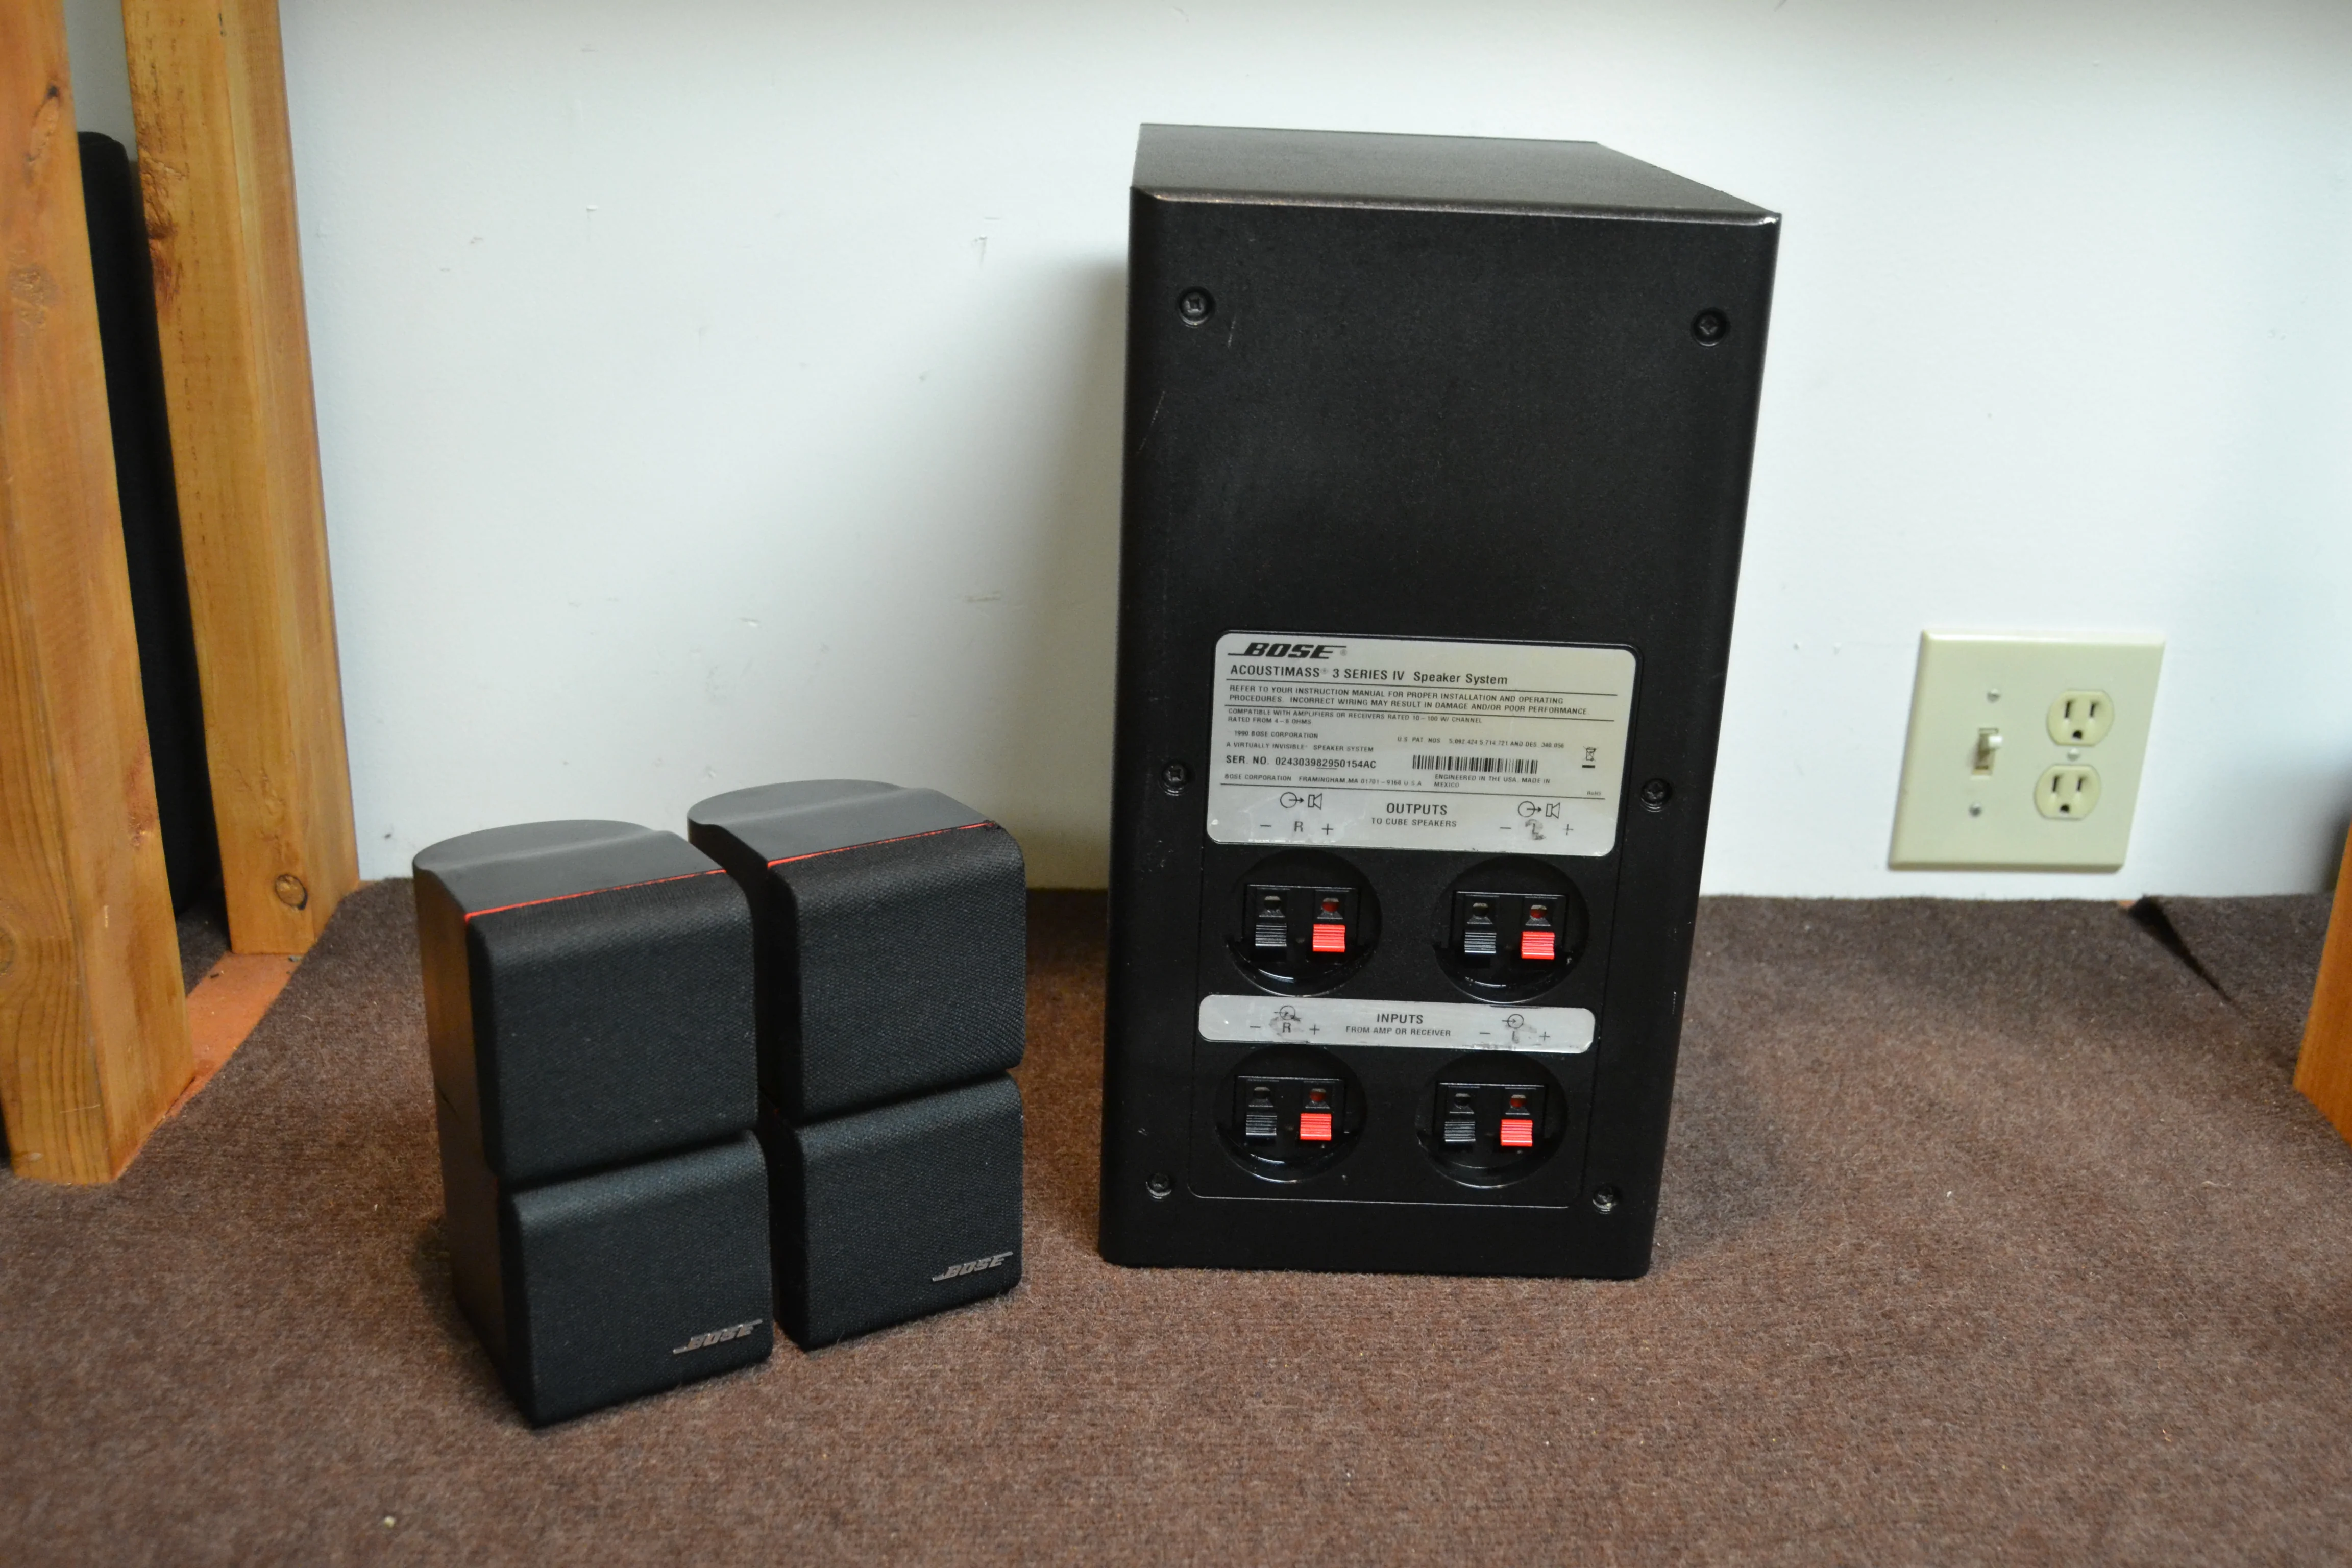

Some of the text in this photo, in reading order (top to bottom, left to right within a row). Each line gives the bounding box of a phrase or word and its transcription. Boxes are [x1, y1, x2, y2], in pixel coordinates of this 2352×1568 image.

[1228, 643, 1346, 659] BOSE
[1231, 665, 1508, 686] ACOUSTIMASS 3 SERIES IV Speaker System
[1295, 687, 1349, 695] INSTRUCTION
[1441, 693, 1497, 701] INSTALLATION
[1518, 696, 1563, 704] OPERATING
[1226, 755, 1377, 768] SER. NO. 024303982950154AC
[1386, 803, 1448, 816] OUTPUTS
[1294, 821, 1304, 832] R
[1386, 818, 1408, 826] CUBE
[1412, 819, 1457, 828] SPEAKERS
[1377, 1013, 1424, 1024] INPUTS
[1282, 1022, 1291, 1033] R
[1373, 1026, 1392, 1035] AMP
[1410, 1028, 1451, 1037] RECEIVER
[932, 1251, 1013, 1282] BOSE
[673, 1319, 762, 1354] BOSE
